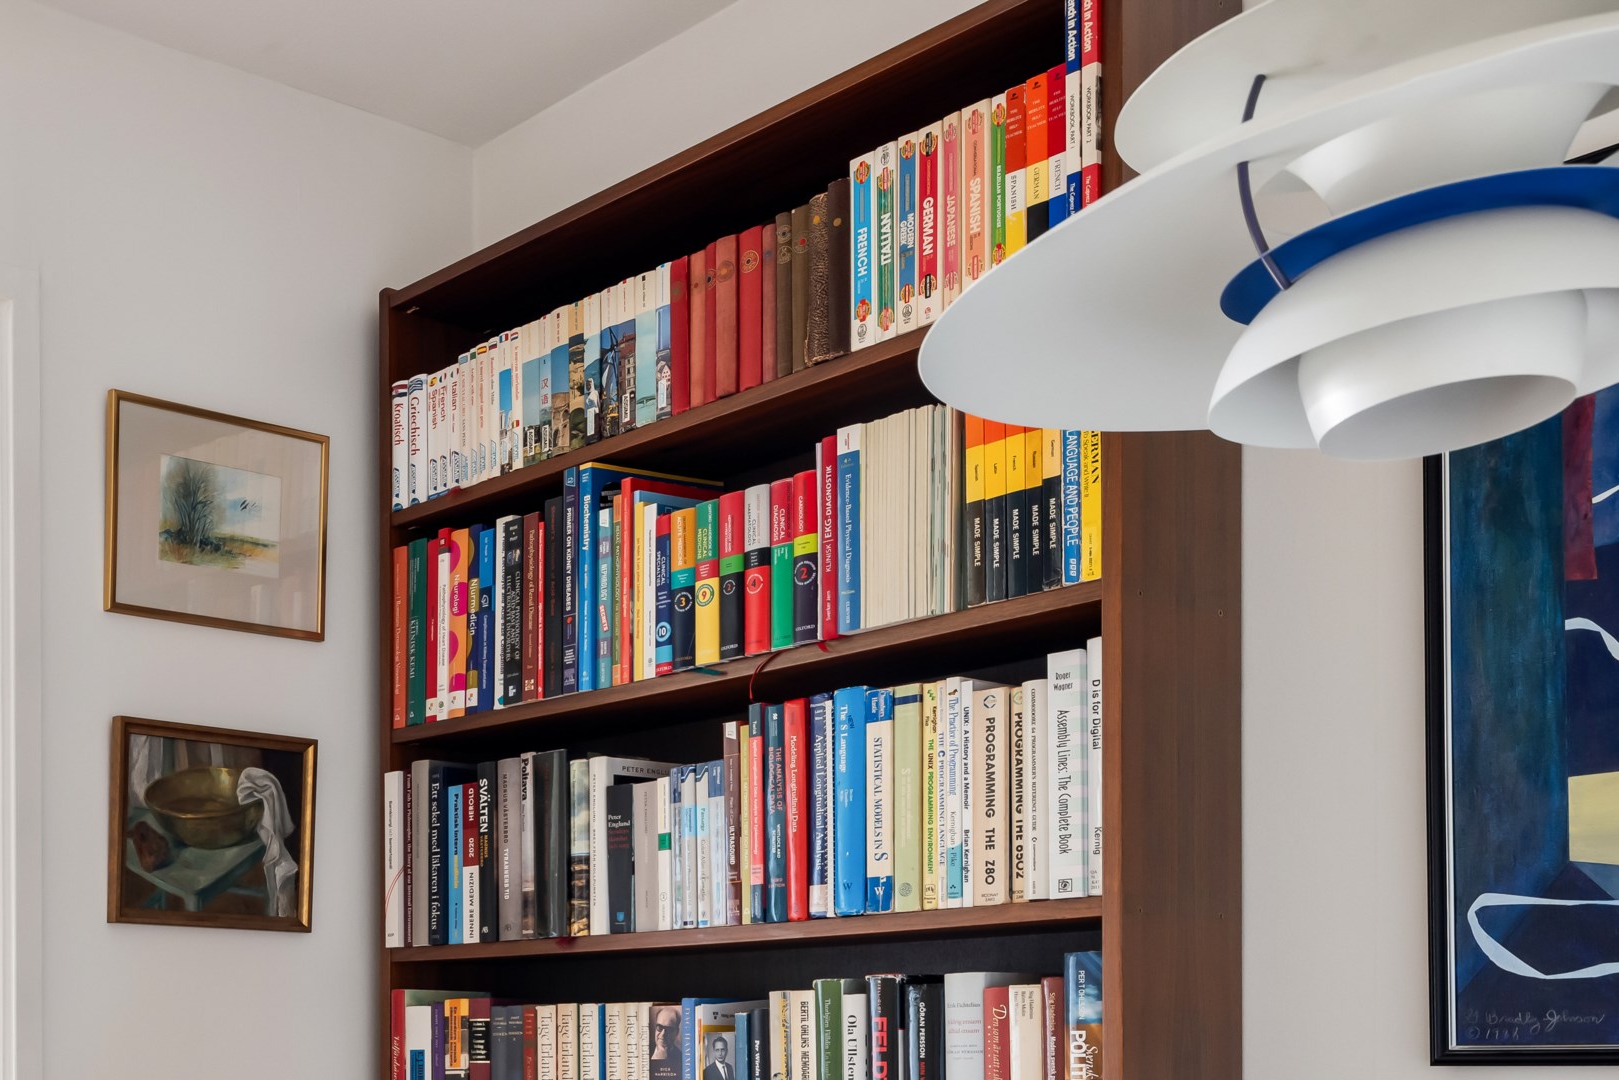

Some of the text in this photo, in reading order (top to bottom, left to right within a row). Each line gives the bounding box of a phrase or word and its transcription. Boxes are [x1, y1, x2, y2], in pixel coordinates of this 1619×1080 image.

[1084, 11, 1093, 21] in
[1084, 21, 1093, 52] Action
[946, 195, 956, 248] JAPANESE
[970, 177, 981, 234] SPANISH
[880, 213, 892, 266] ITALIAN
[900, 220, 908, 247] GREEK
[922, 196, 934, 256] GERMAN
[857, 227, 868, 277] FRENCH
[451, 381, 459, 411] Italian
[393, 403, 404, 446] Kroatisch
[409, 396, 420, 456] Griechisch
[824, 465, 833, 539] EKG-DIAGNOSTIK
[1065, 430, 1079, 547] LANGUAGE AND PEOPLE
[566, 536, 572, 547] ON
[582, 494, 591, 551] Biochemistry
[843, 473, 852, 583] Evidence-Based Physical Diagnosis
[452, 574, 460, 614] Neurologi
[469, 578, 478, 636] Njurmedicin
[600, 604, 609, 632] SECRETS
[949, 697, 959, 710] The
[1053, 683, 1073, 692] Wagner
[949, 712, 959, 737] Practice
[1090, 679, 1101, 750] D is for Digital
[949, 738, 959, 748] of
[431, 783, 440, 800] Ett
[522, 758, 530, 801] Poltava
[789, 735, 799, 833] Modeling Longitudinal Data
[948, 748, 959, 796] Programming
[1056, 709, 1072, 855] Assembly Lines: The Complete Book
[431, 801, 440, 827] sekel
[479, 778, 491, 833] SVÄLTEN
[814, 734, 825, 871] Applied Longitudinal Analysis
[873, 737, 889, 862] STATISTICAL MODELS IN S
[985, 716, 996, 885] PROGRAMMING THE Z80
[431, 829, 440, 852] med
[728, 825, 736, 865] ULTRASOUND
[949, 811, 957, 845] Kernighan
[431, 854, 441, 893] läkaren
[431, 902, 441, 930] fokus
[539, 1012, 553, 1040] Tage
[559, 1010, 573, 1039] Tage
[579, 1010, 594, 1039] Tage
[606, 1010, 620, 1039] Tage
[625, 1014, 638, 1041] Tage
[847, 1014, 858, 1035] Ola
[847, 1037, 858, 1080] Ullsten
[1084, 1043, 1099, 1080] Svensk
